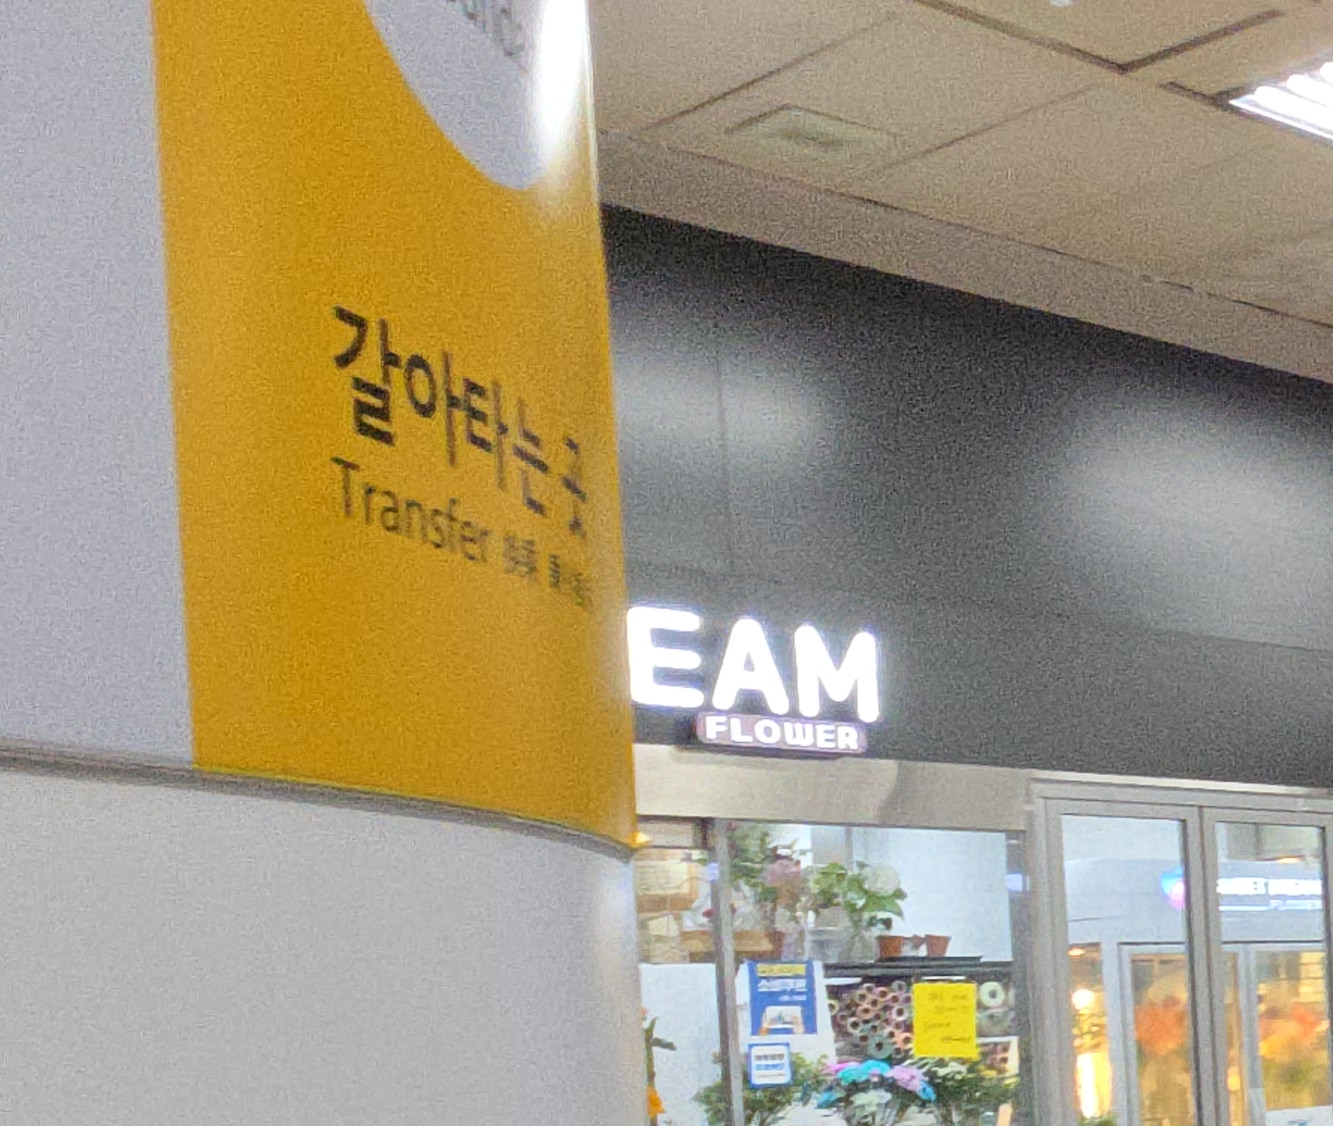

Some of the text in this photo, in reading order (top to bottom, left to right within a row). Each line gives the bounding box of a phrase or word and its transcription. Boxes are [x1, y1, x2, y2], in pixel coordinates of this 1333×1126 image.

[332, 304, 552, 519] 갈아타는
[330, 455, 491, 563] Transfer
[704, 714, 860, 751] FLOWER
